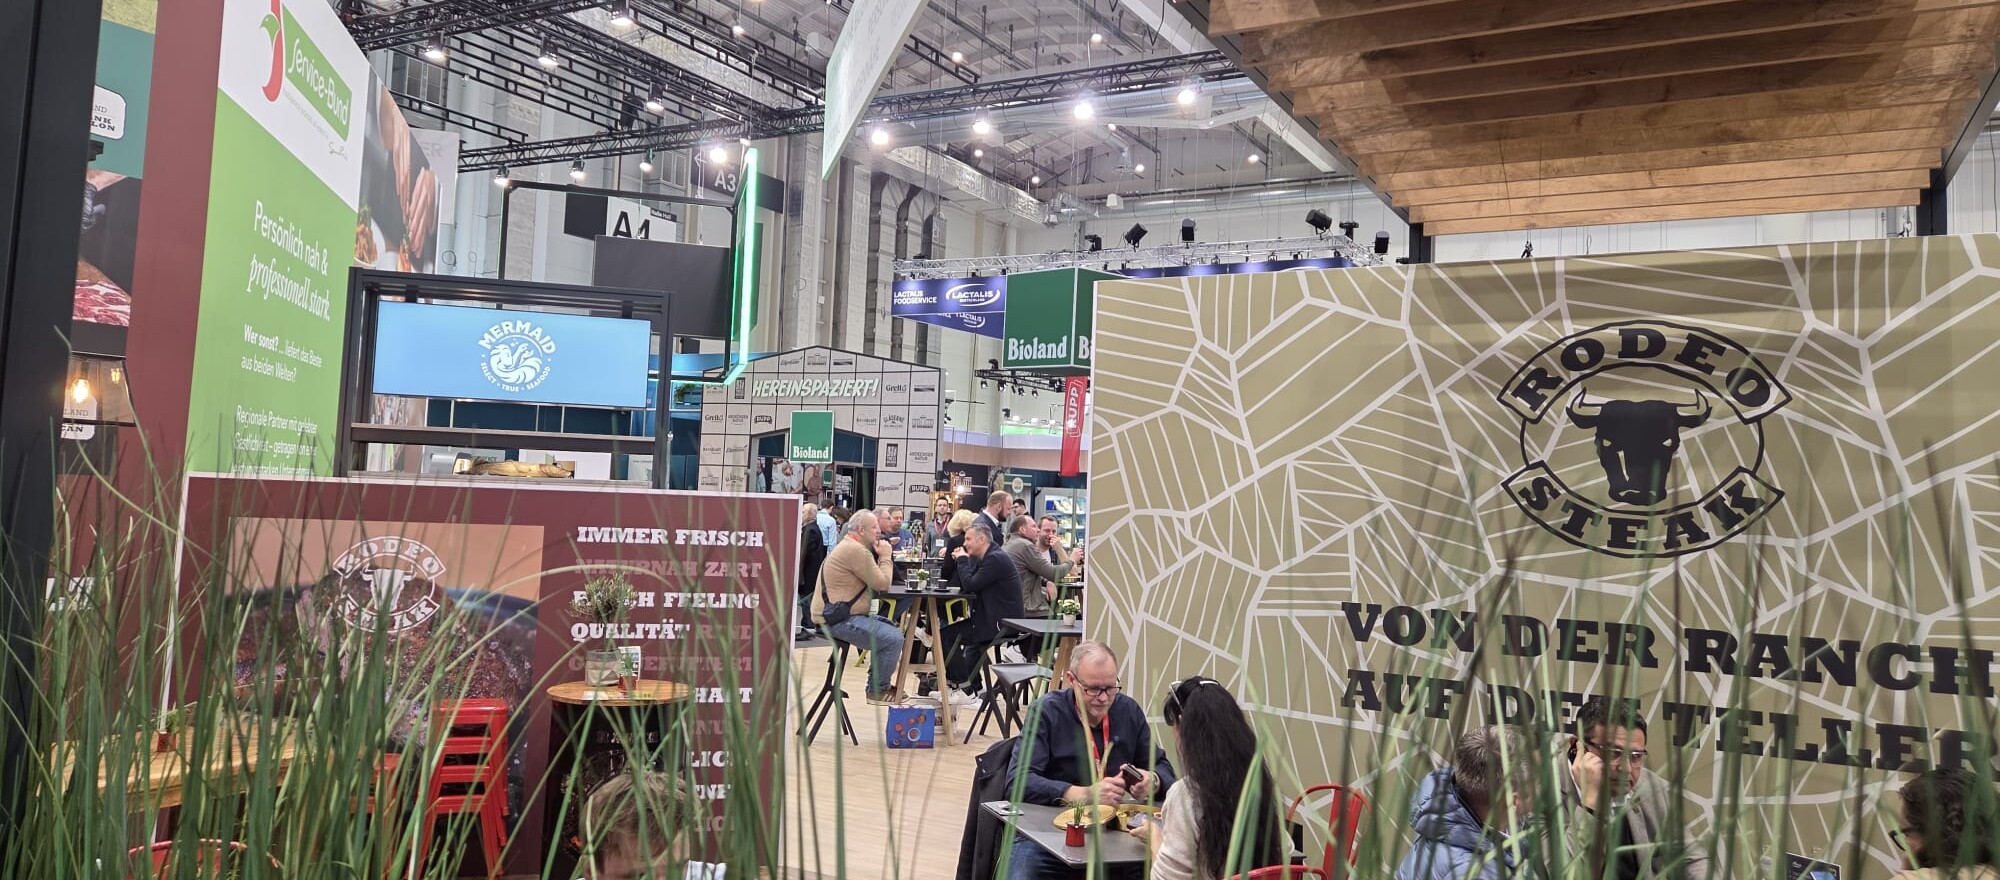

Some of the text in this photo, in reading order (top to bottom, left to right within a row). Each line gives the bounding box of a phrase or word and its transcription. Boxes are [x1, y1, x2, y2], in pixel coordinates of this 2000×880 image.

[288, 38, 349, 126] Service-Bund
[714, 169, 736, 193] A3
[254, 200, 329, 277] Persönlich nah &
[246, 253, 310, 310] professionell
[893, 290, 924, 298] LACTALIS
[951, 289, 994, 299] LACTALIS
[893, 296, 937, 305] FOODSERVICE
[244, 323, 258, 345] Wer
[258, 333, 279, 353] sonst?
[478, 320, 556, 354] MERMAID
[1008, 335, 1068, 361] Bioland
[241, 355, 253, 371] aus
[253, 354, 275, 378] beiden
[1510, 326, 1772, 412] RODEO
[752, 378, 880, 398] HEREINSPAZIERT!
[793, 445, 828, 459] Bioland
[1517, 475, 1766, 551] STEAK
[577, 526, 764, 547] IMMER FRISCH
[337, 539, 439, 575] RODEO
[704, 561, 762, 578] ZART
[664, 591, 760, 609] FEELING
[570, 618, 690, 643] QUALITÄT
[1342, 601, 1996, 699] VON DER RANCH
[1341, 668, 1465, 719] AUF
[1485, 683, 1642, 734] DE
